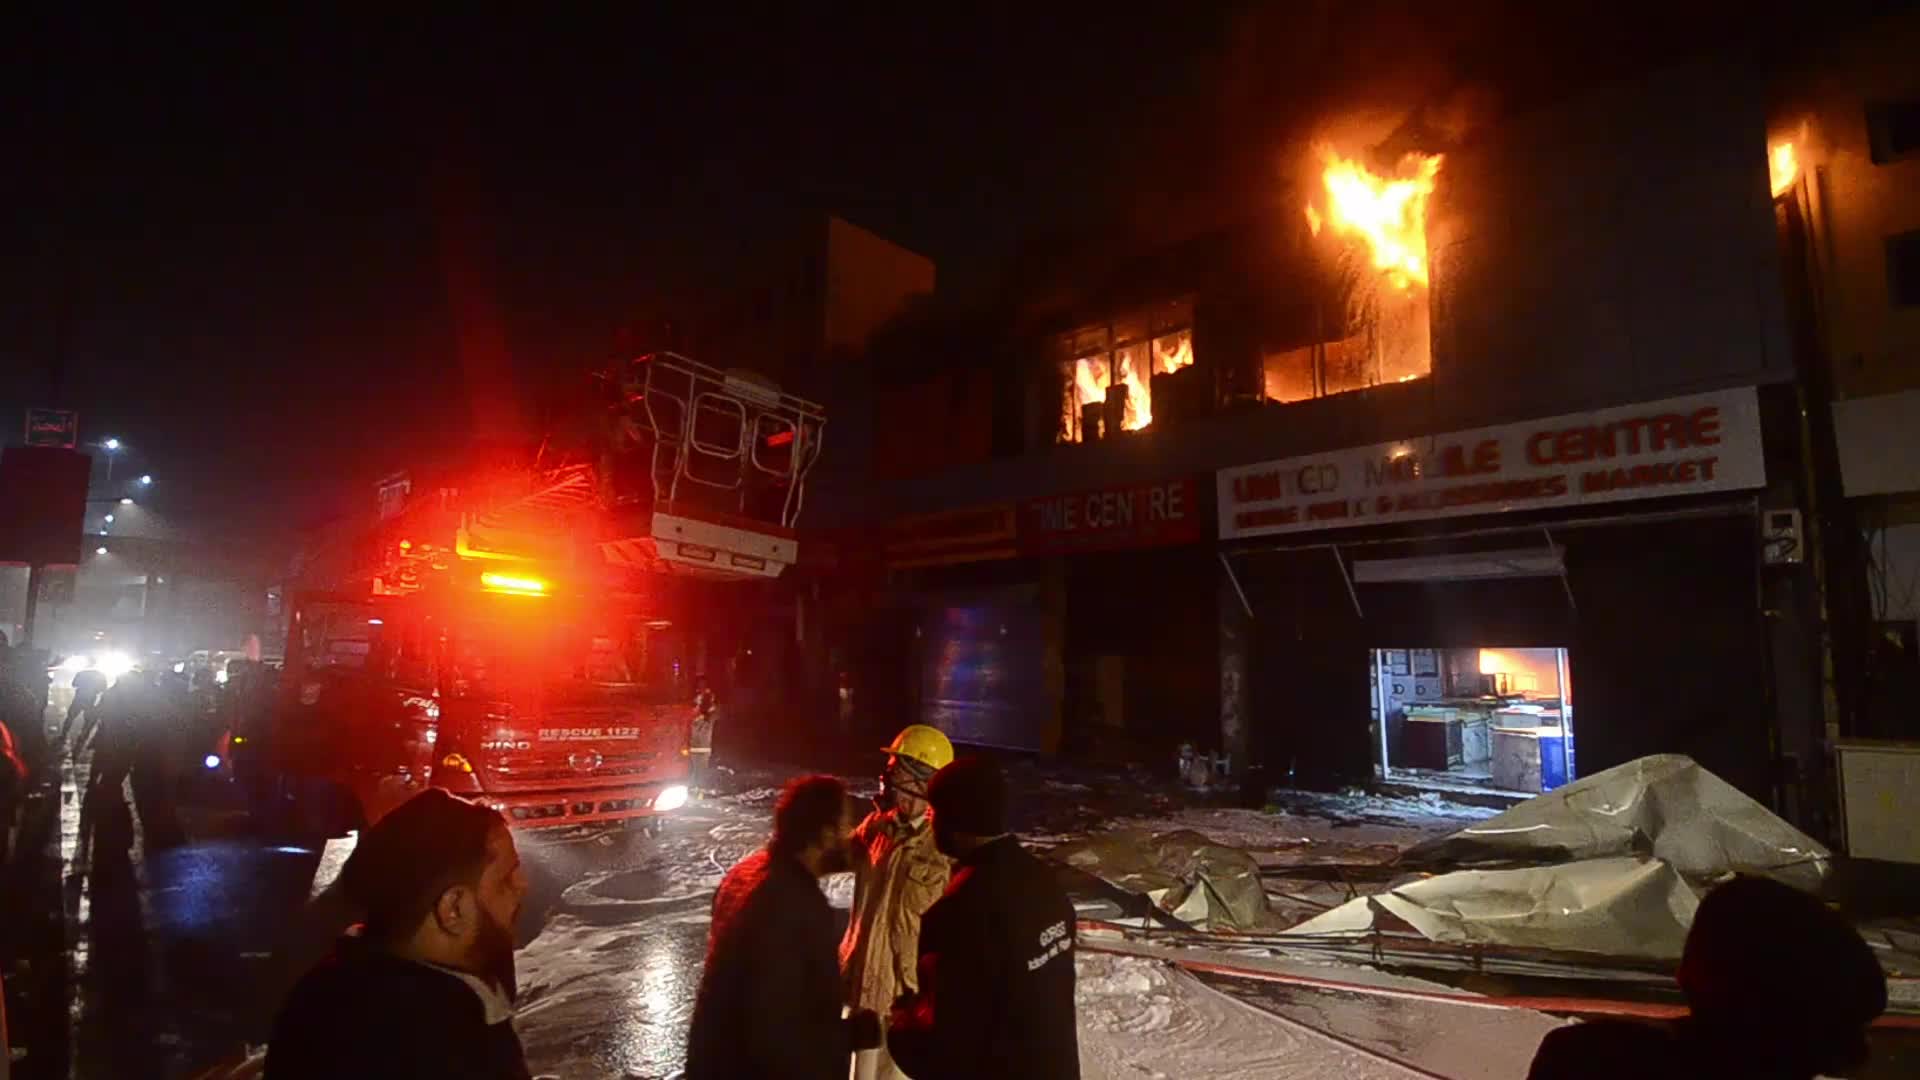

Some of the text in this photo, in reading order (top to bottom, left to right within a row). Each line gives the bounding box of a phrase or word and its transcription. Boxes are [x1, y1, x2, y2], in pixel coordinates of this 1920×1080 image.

[1527, 406, 1720, 466] CENTRE
[1582, 456, 1718, 494] MARKET
[538, 727, 640, 737] RESCUE 1122
